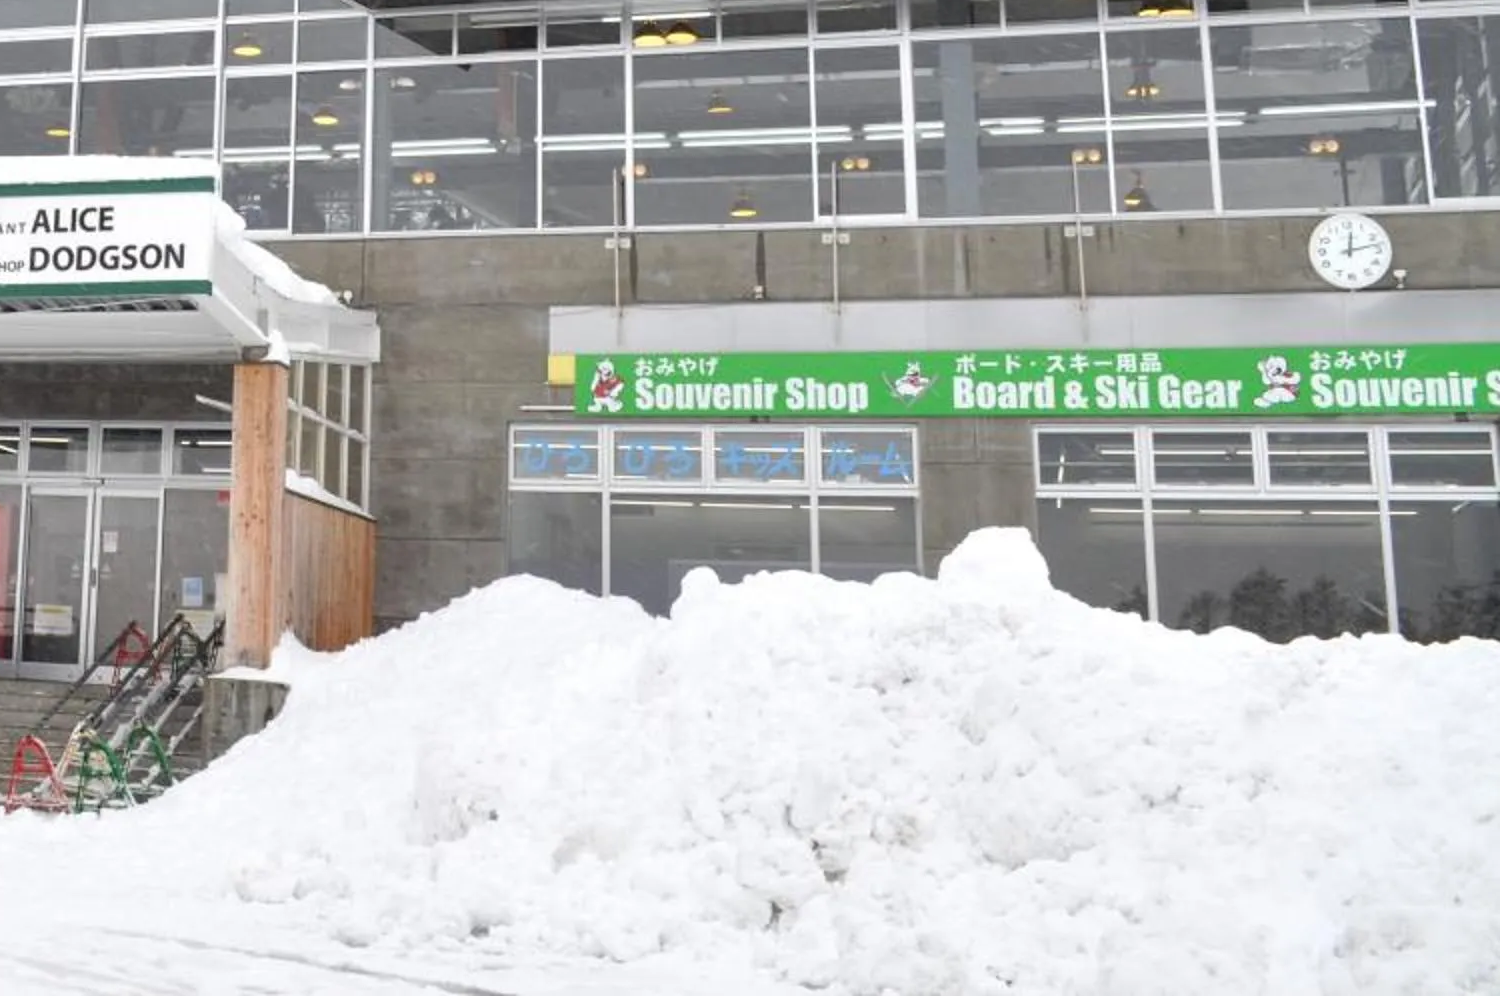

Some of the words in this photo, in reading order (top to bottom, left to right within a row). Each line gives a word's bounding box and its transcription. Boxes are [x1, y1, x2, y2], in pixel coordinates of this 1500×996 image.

[31, 206, 114, 234] ALICE
[29, 243, 185, 272] DODGSON
[634, 357, 719, 377] おみやげ
[1309, 349, 1407, 371] おみやげ
[635, 377, 779, 411] Souvenir
[785, 377, 869, 413] Shop
[953, 375, 1056, 409] Board
[1064, 379, 1090, 409] &
[1095, 375, 1149, 409] Ski
[1158, 375, 1242, 409] Gear
[1311, 371, 1478, 409] Souvenir
